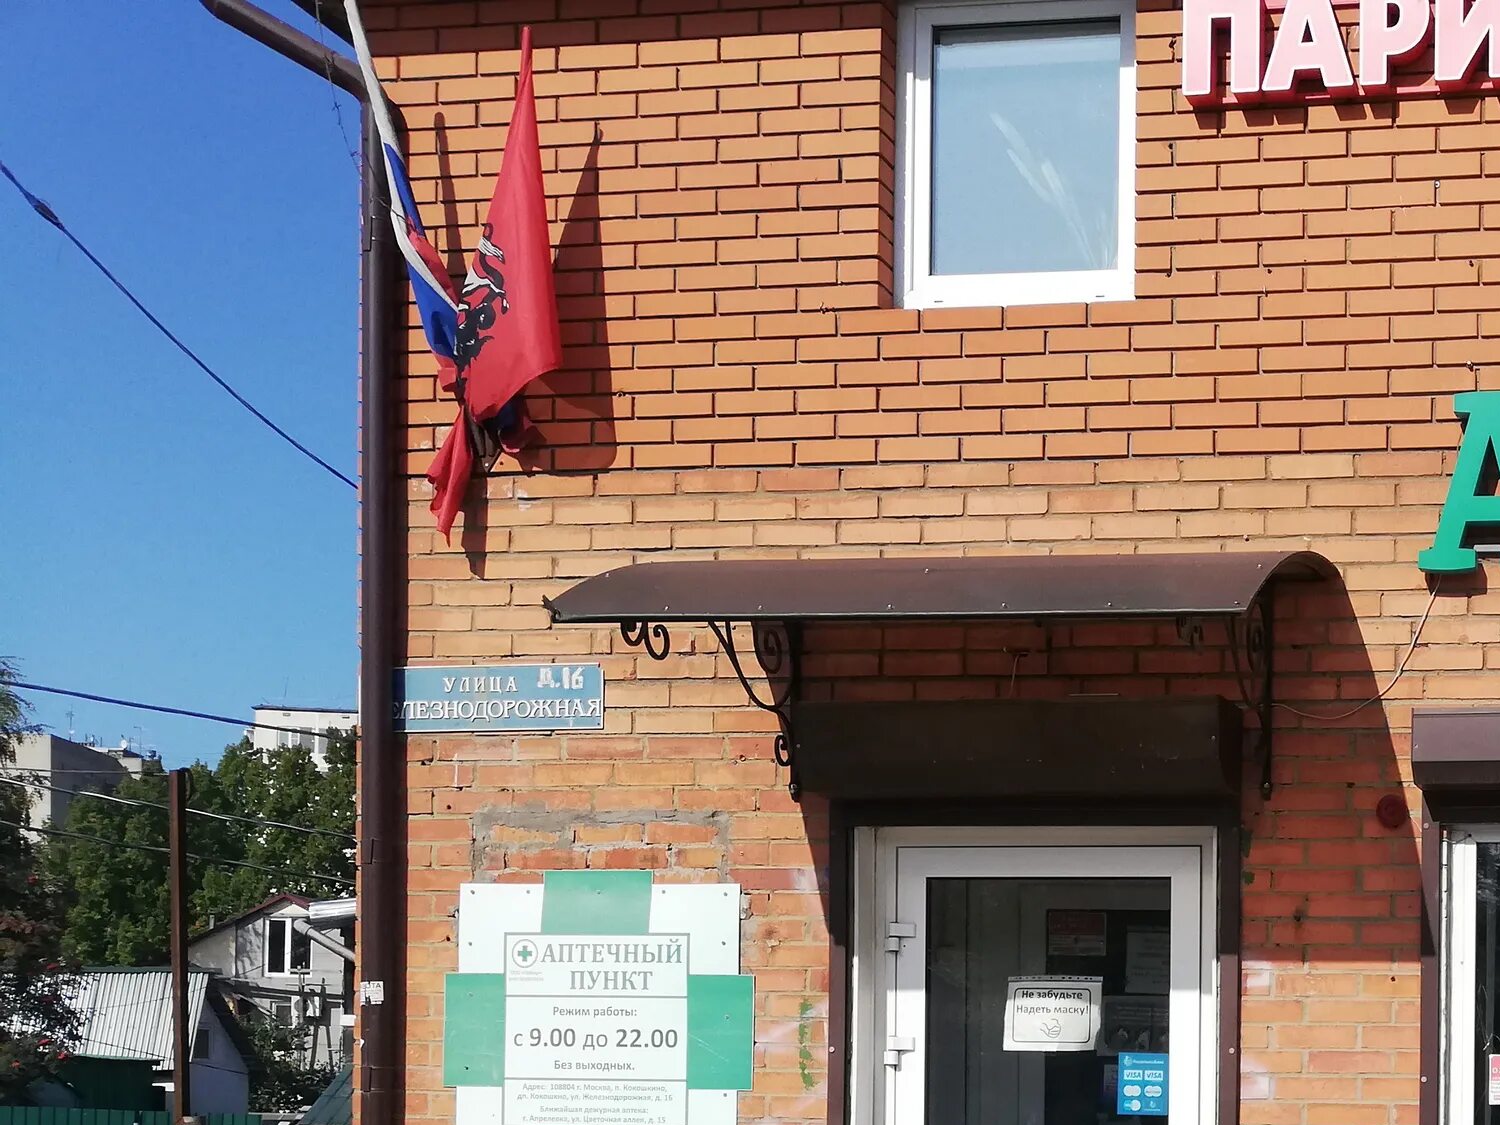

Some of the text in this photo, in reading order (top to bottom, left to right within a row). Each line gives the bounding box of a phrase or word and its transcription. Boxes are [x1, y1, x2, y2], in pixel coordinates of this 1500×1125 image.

[443, 676, 518, 693] УЛИЦА
[541, 938, 682, 964] АПТЕЧНЫЙ
[569, 970, 653, 991] ПУНКТ
[1022, 989, 1084, 1001] Не забудьте
[553, 1006, 638, 1019] Режим работы:
[1016, 1004, 1089, 1016] Надеть маску!
[529, 1028, 576, 1047] 9.00
[582, 1034, 608, 1051] до
[615, 1029, 679, 1048] 22.00
[554, 1060, 635, 1072] Без выходных.
[1125, 1071, 1142, 1079] VISA
